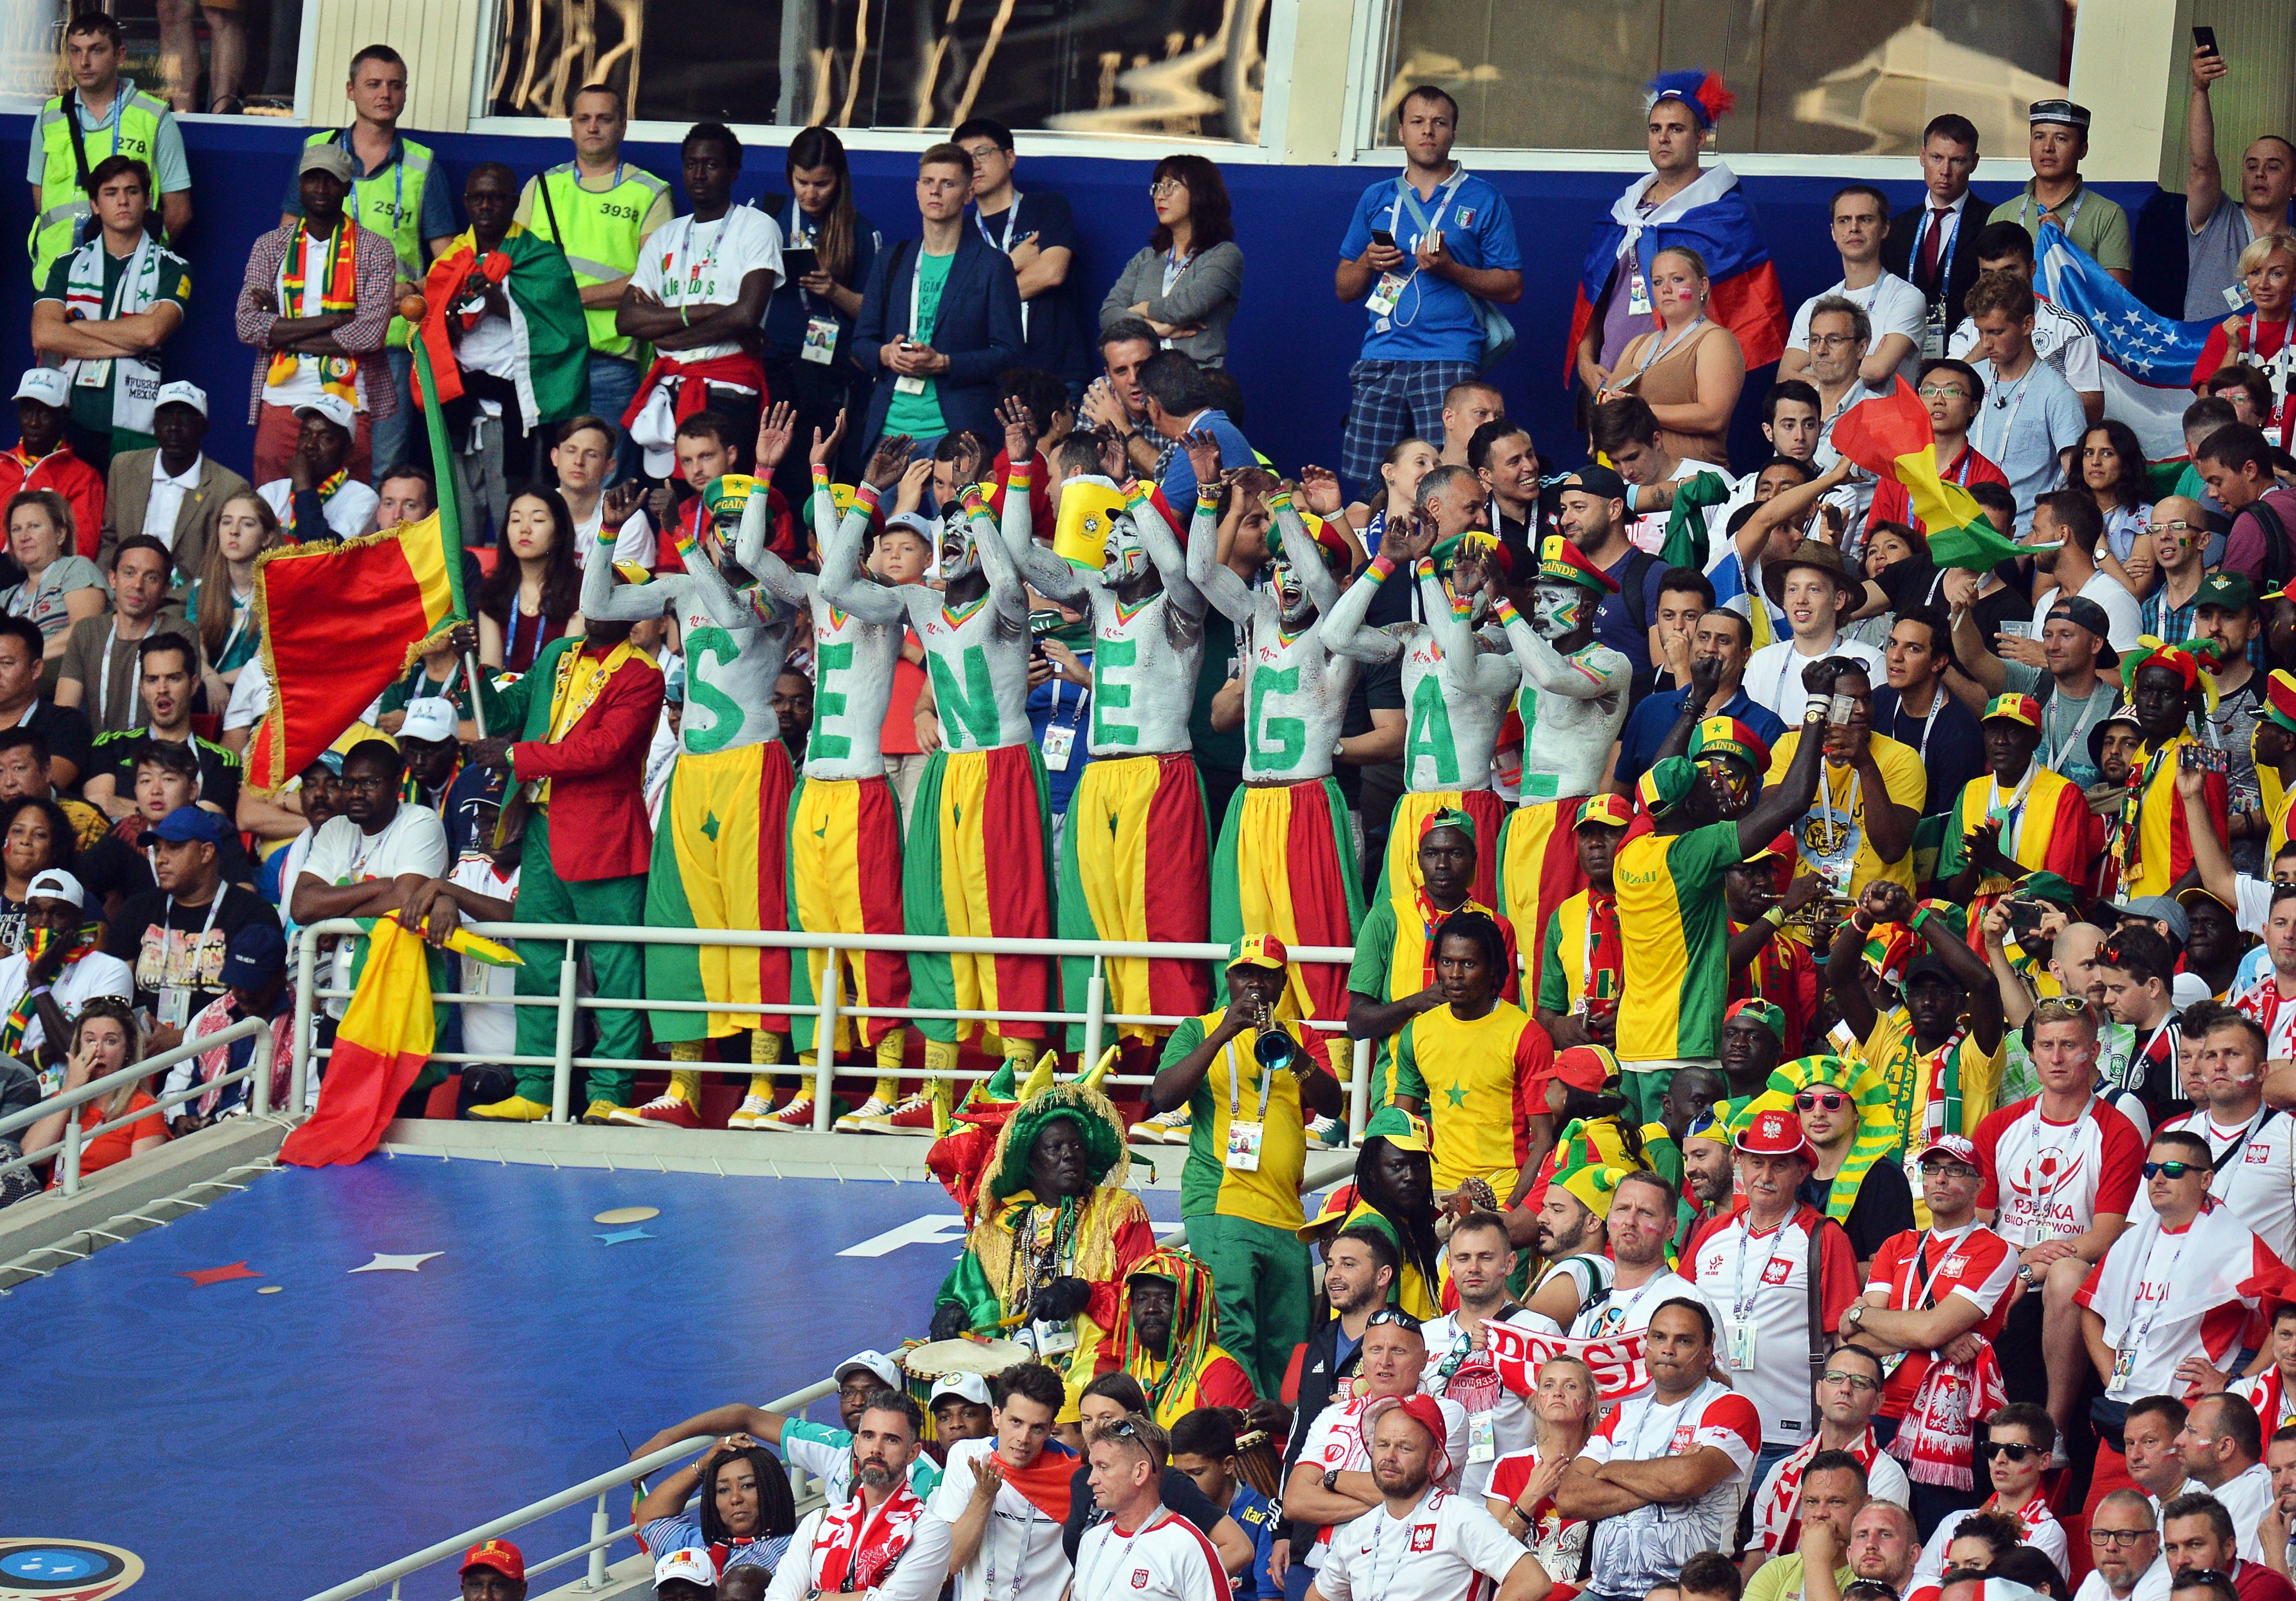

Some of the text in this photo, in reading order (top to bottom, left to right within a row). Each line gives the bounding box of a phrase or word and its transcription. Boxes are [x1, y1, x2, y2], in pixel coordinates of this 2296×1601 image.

[600, 204, 638, 222] 3938
[1444, 559, 1454, 569] 12
[1930, 697, 1941, 718] KAZAN
[2015, 1199, 2075, 1221] POSKA
[1493, 1326, 1651, 1393] POS
[1600, 1406, 1612, 1414] CU
[1241, 1505, 1267, 1525] Itaú
[660, 1560, 700, 1575] SENEGAL
